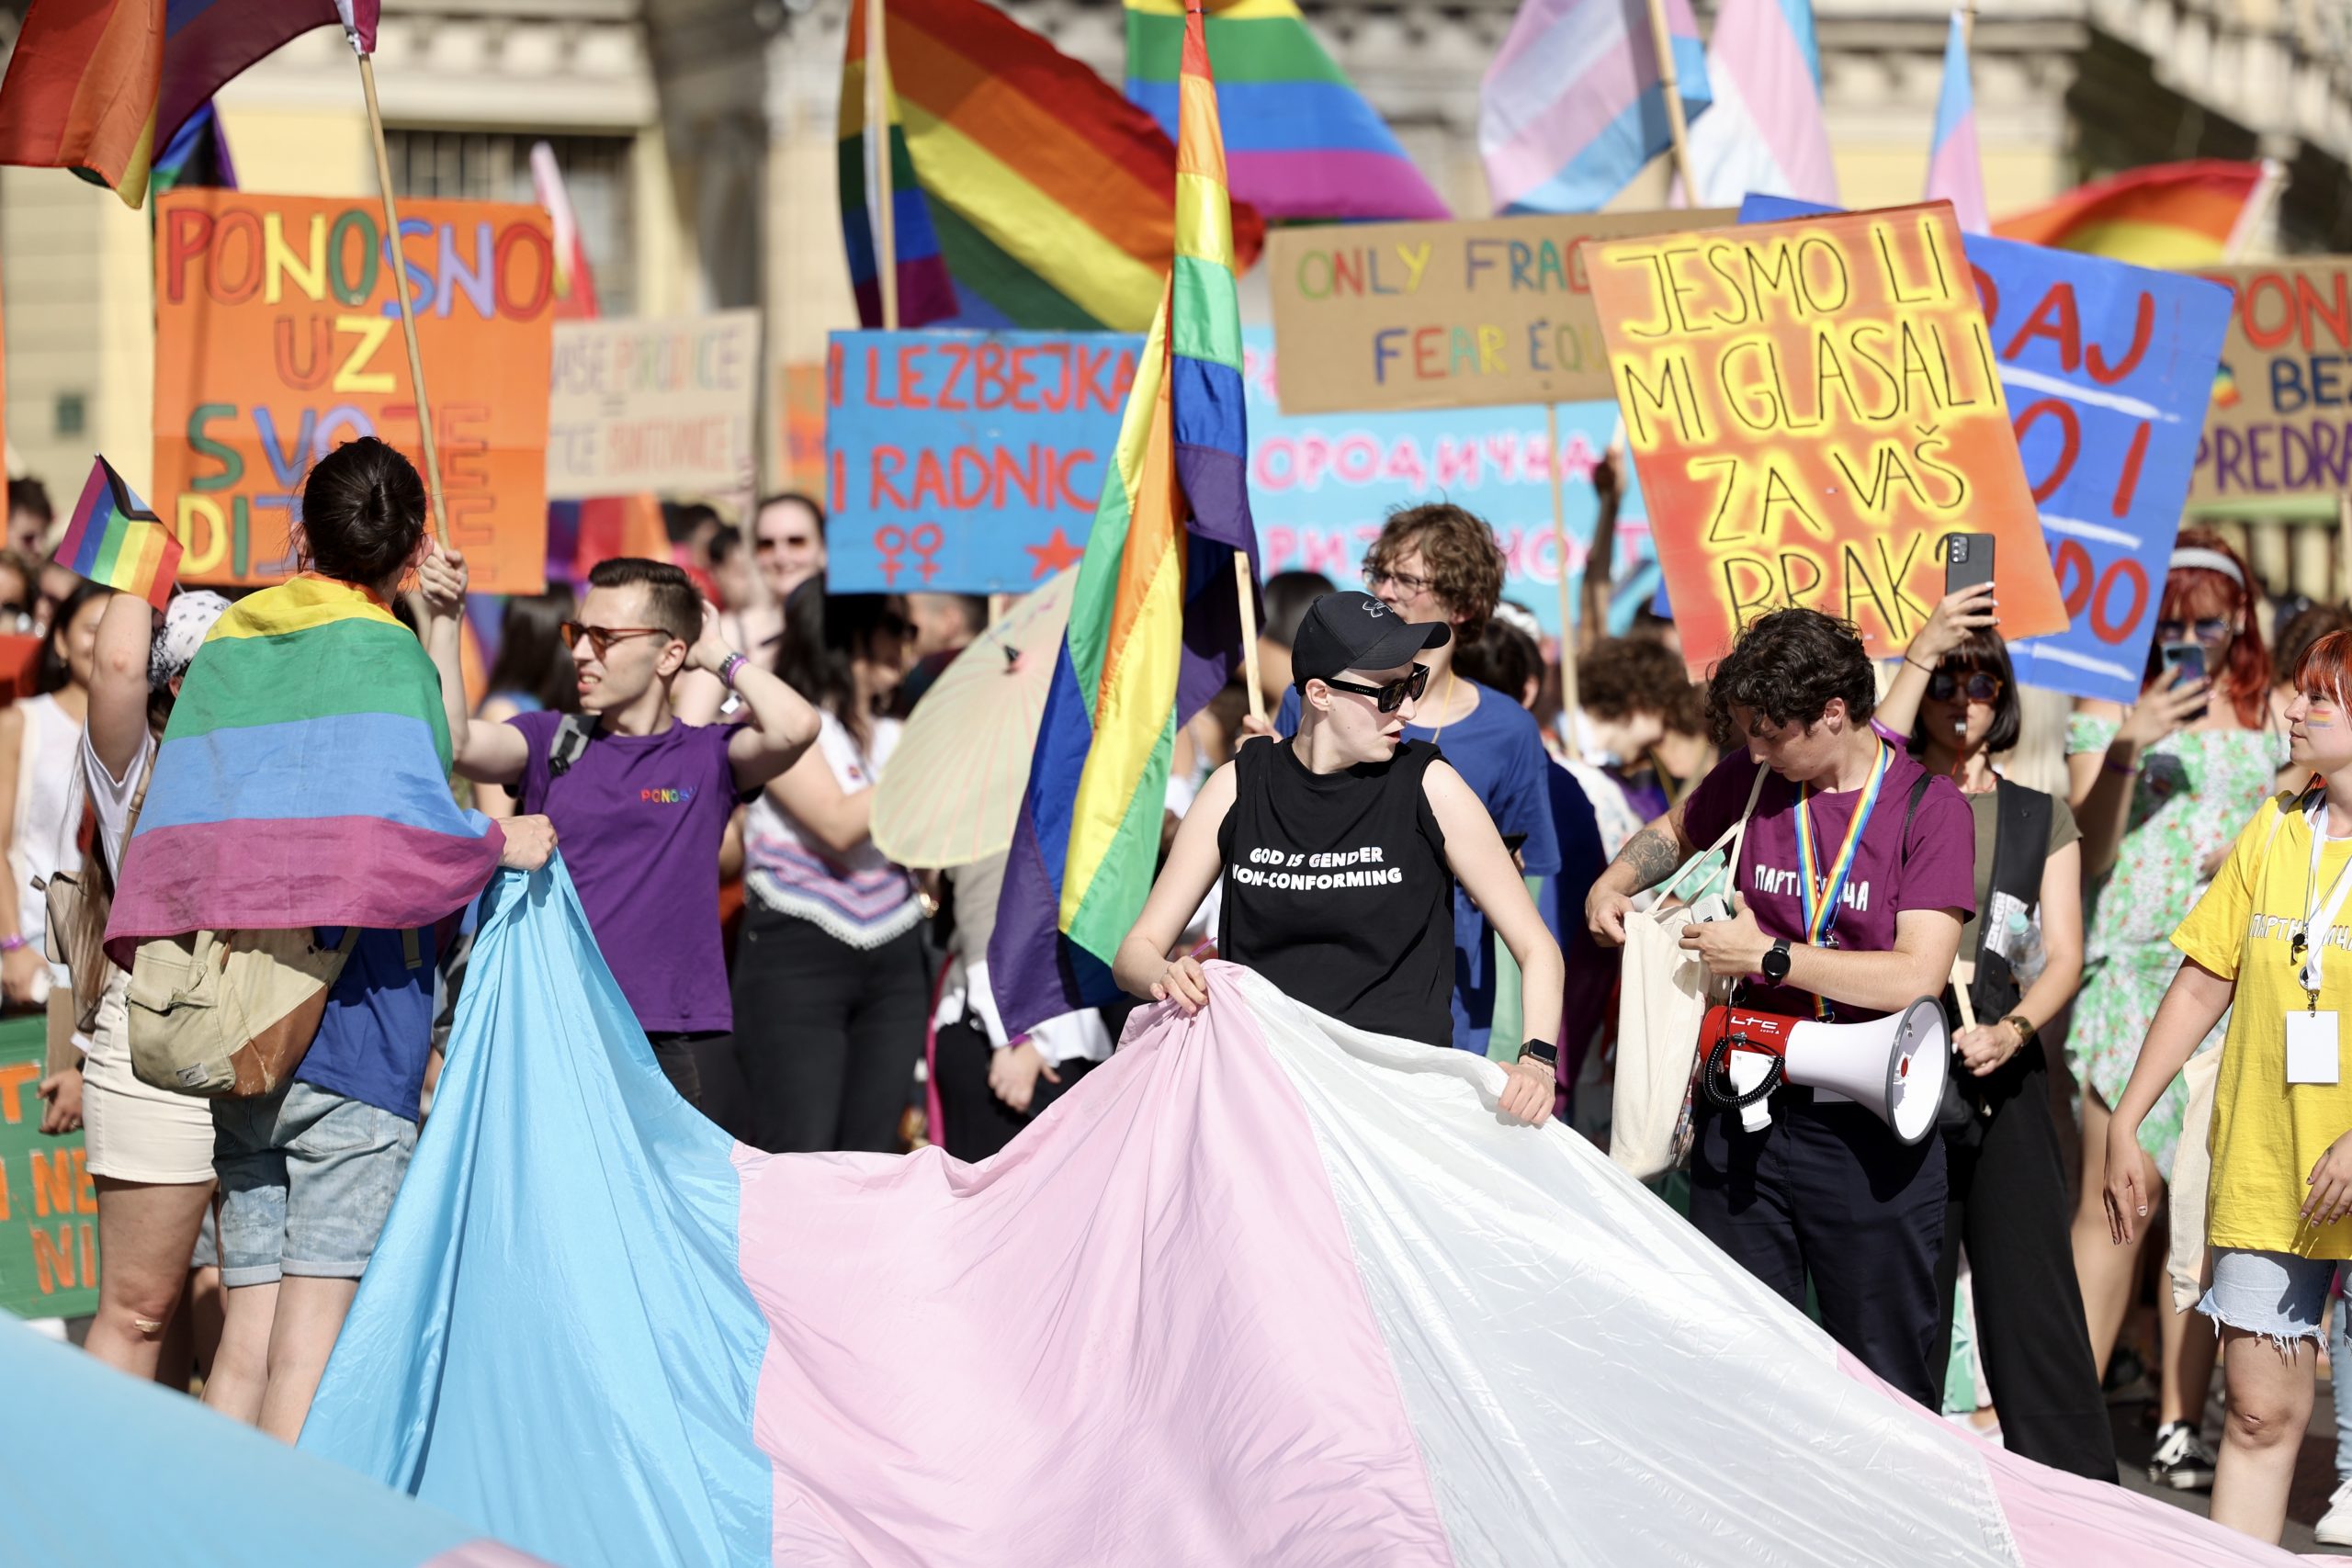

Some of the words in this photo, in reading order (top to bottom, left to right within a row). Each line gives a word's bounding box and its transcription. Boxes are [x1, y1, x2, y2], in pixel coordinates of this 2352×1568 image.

[167, 209, 553, 321] PONOSNO
[1295, 240, 1431, 300] ONLY
[1617, 238, 1849, 337] JESMO
[1876, 222, 1950, 303] LI
[276, 314, 397, 392] UZ
[831, 341, 844, 408] I
[865, 342, 1137, 414] LEZBEJKA
[1374, 325, 1509, 386] FEAR
[1624, 355, 1705, 444] MI
[1721, 320, 1998, 430] GLASALI
[2269, 355, 2352, 412] BE
[832, 447, 846, 514] I
[870, 442, 1100, 513] RADNIC
[1695, 458, 1822, 542] ZA
[1834, 423, 1964, 512] VAŠ
[1250, 848, 1284, 865] GOD
[1286, 854, 1306, 867] IS
[1308, 847, 1385, 868] GENDER
[1755, 864, 1870, 911] ПАРТЧА
